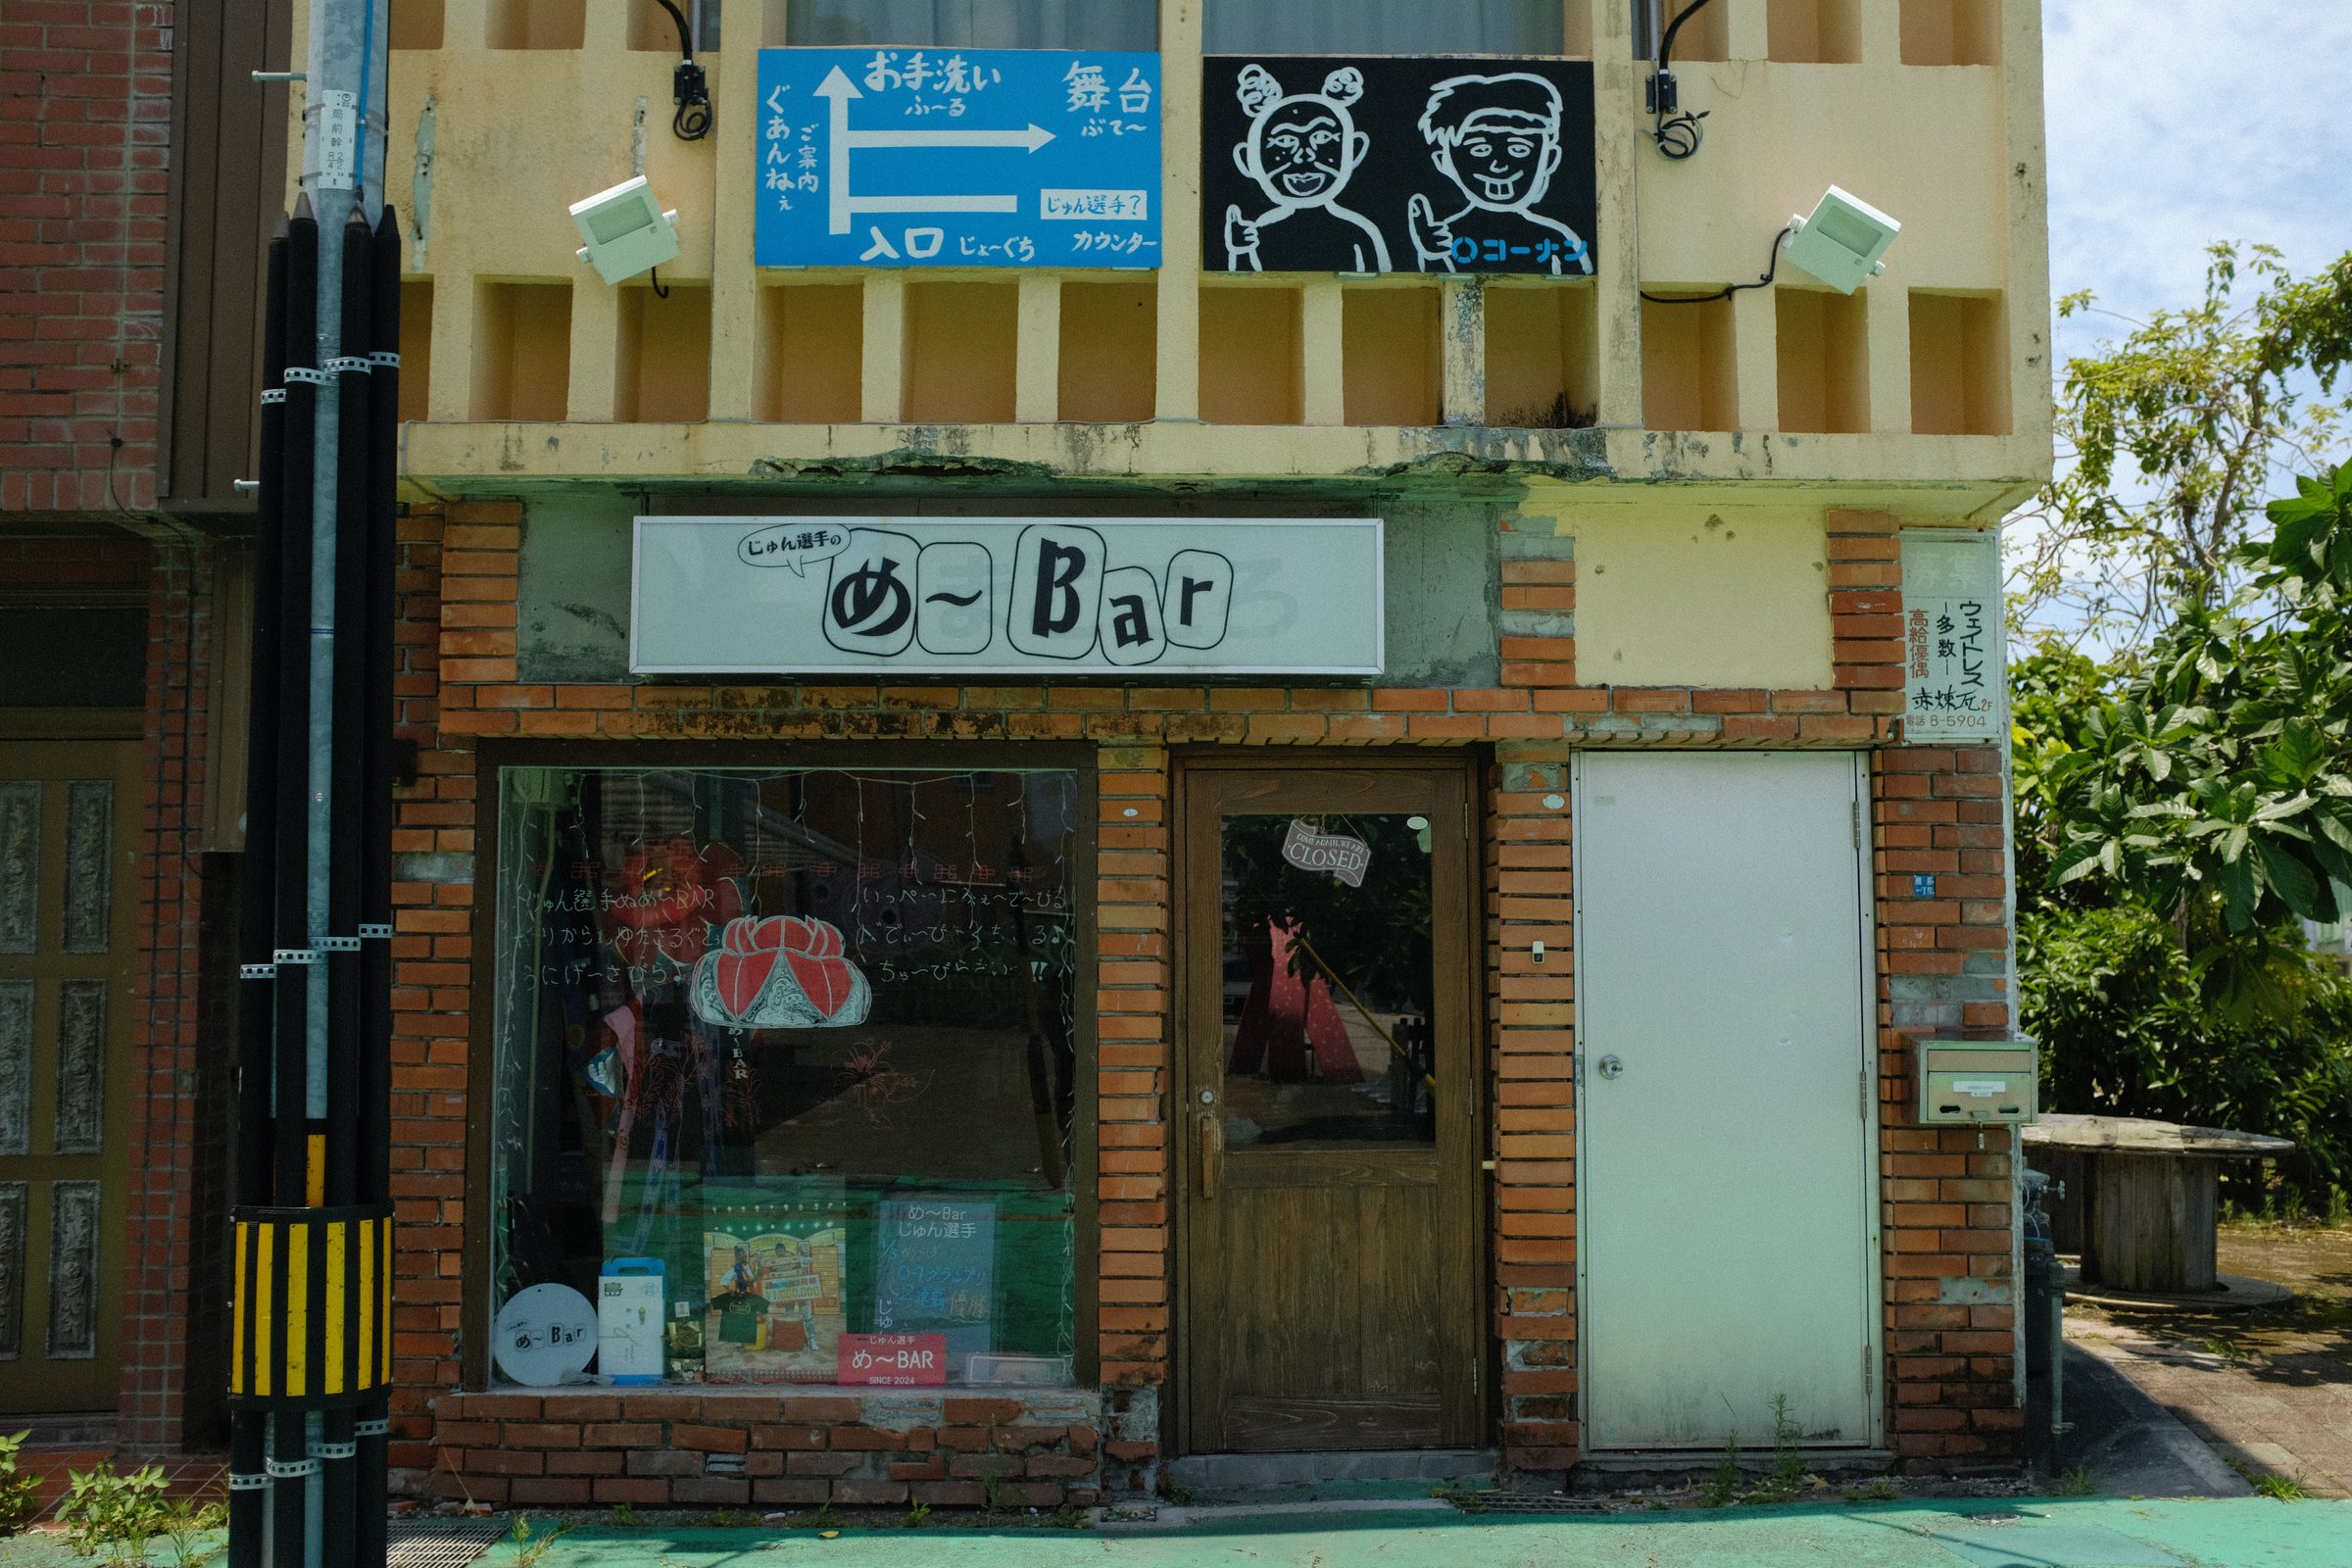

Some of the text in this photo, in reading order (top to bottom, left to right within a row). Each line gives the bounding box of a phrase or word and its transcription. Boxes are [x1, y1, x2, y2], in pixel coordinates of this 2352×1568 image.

[863, 51, 1002, 95] お手洗い
[1061, 60, 1152, 115] 舞台
[798, 123, 819, 194] ご案内
[859, 225, 945, 262] 入口
[1071, 230, 1157, 255] カウンター
[748, 530, 842, 556] じゅん選手の
[1959, 600, 1984, 687] ウェイトレス
[1981, 698, 1993, 711] 2F
[1930, 714, 1987, 727] 8-5904
[1290, 843, 1361, 870] CLOSED
[1297, 833, 1315, 846] COME
[1351, 844, 1364, 855] ARE
[899, 1222, 977, 1239] じゅん選手
[869, 1335, 916, 1345] じゅん選手
